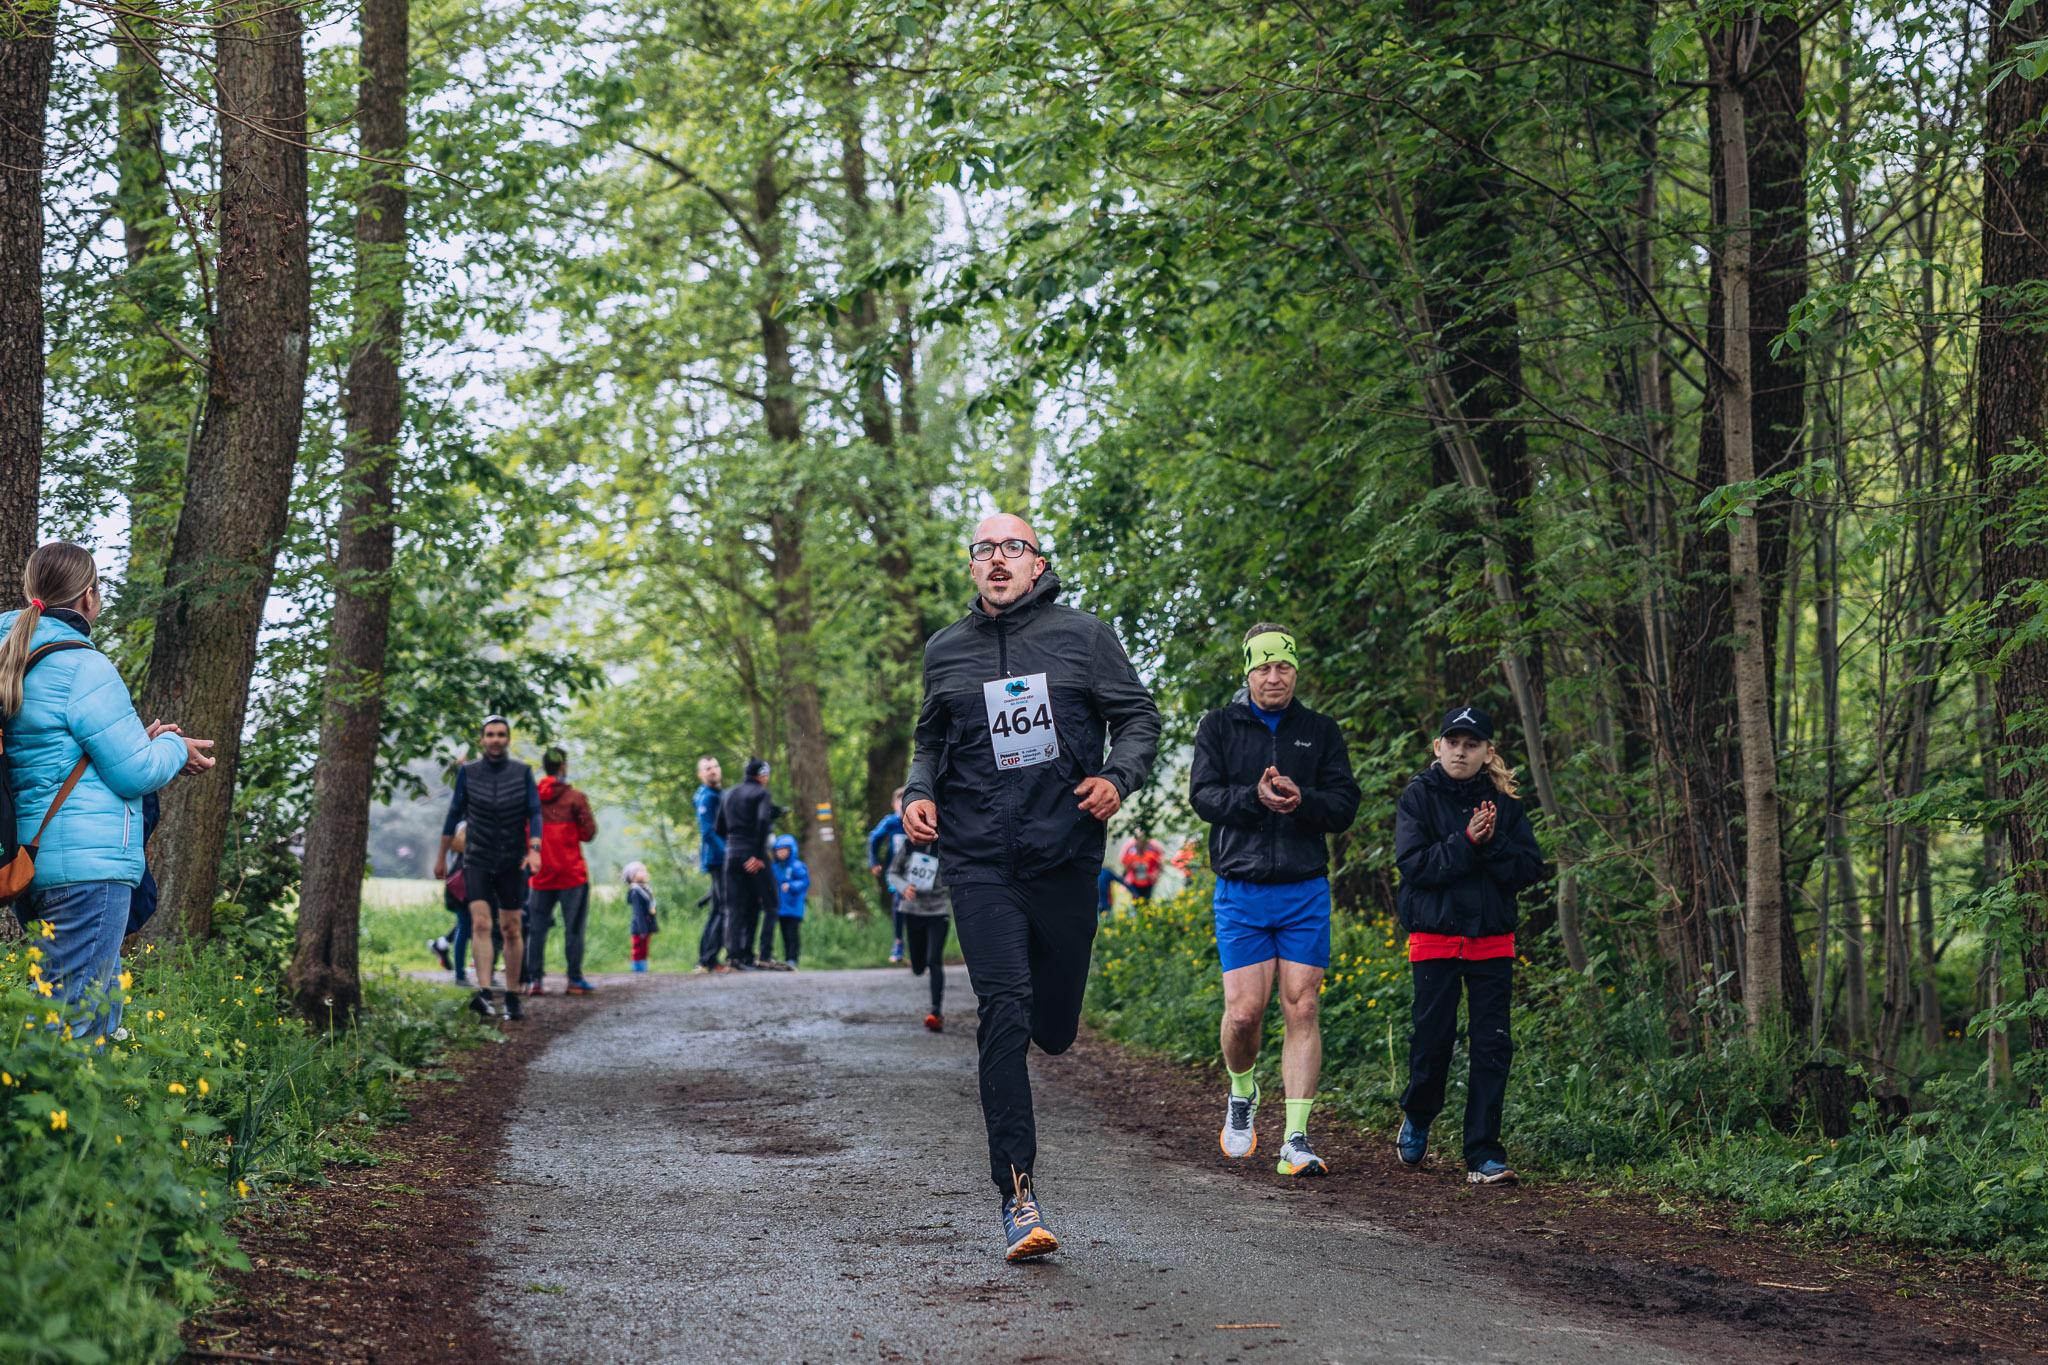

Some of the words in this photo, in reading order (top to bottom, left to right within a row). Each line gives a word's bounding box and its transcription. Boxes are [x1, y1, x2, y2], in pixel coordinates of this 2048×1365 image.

[992, 703, 1052, 737] 464
[1001, 757, 1021, 766] CUP
[911, 867, 935, 880] 407
